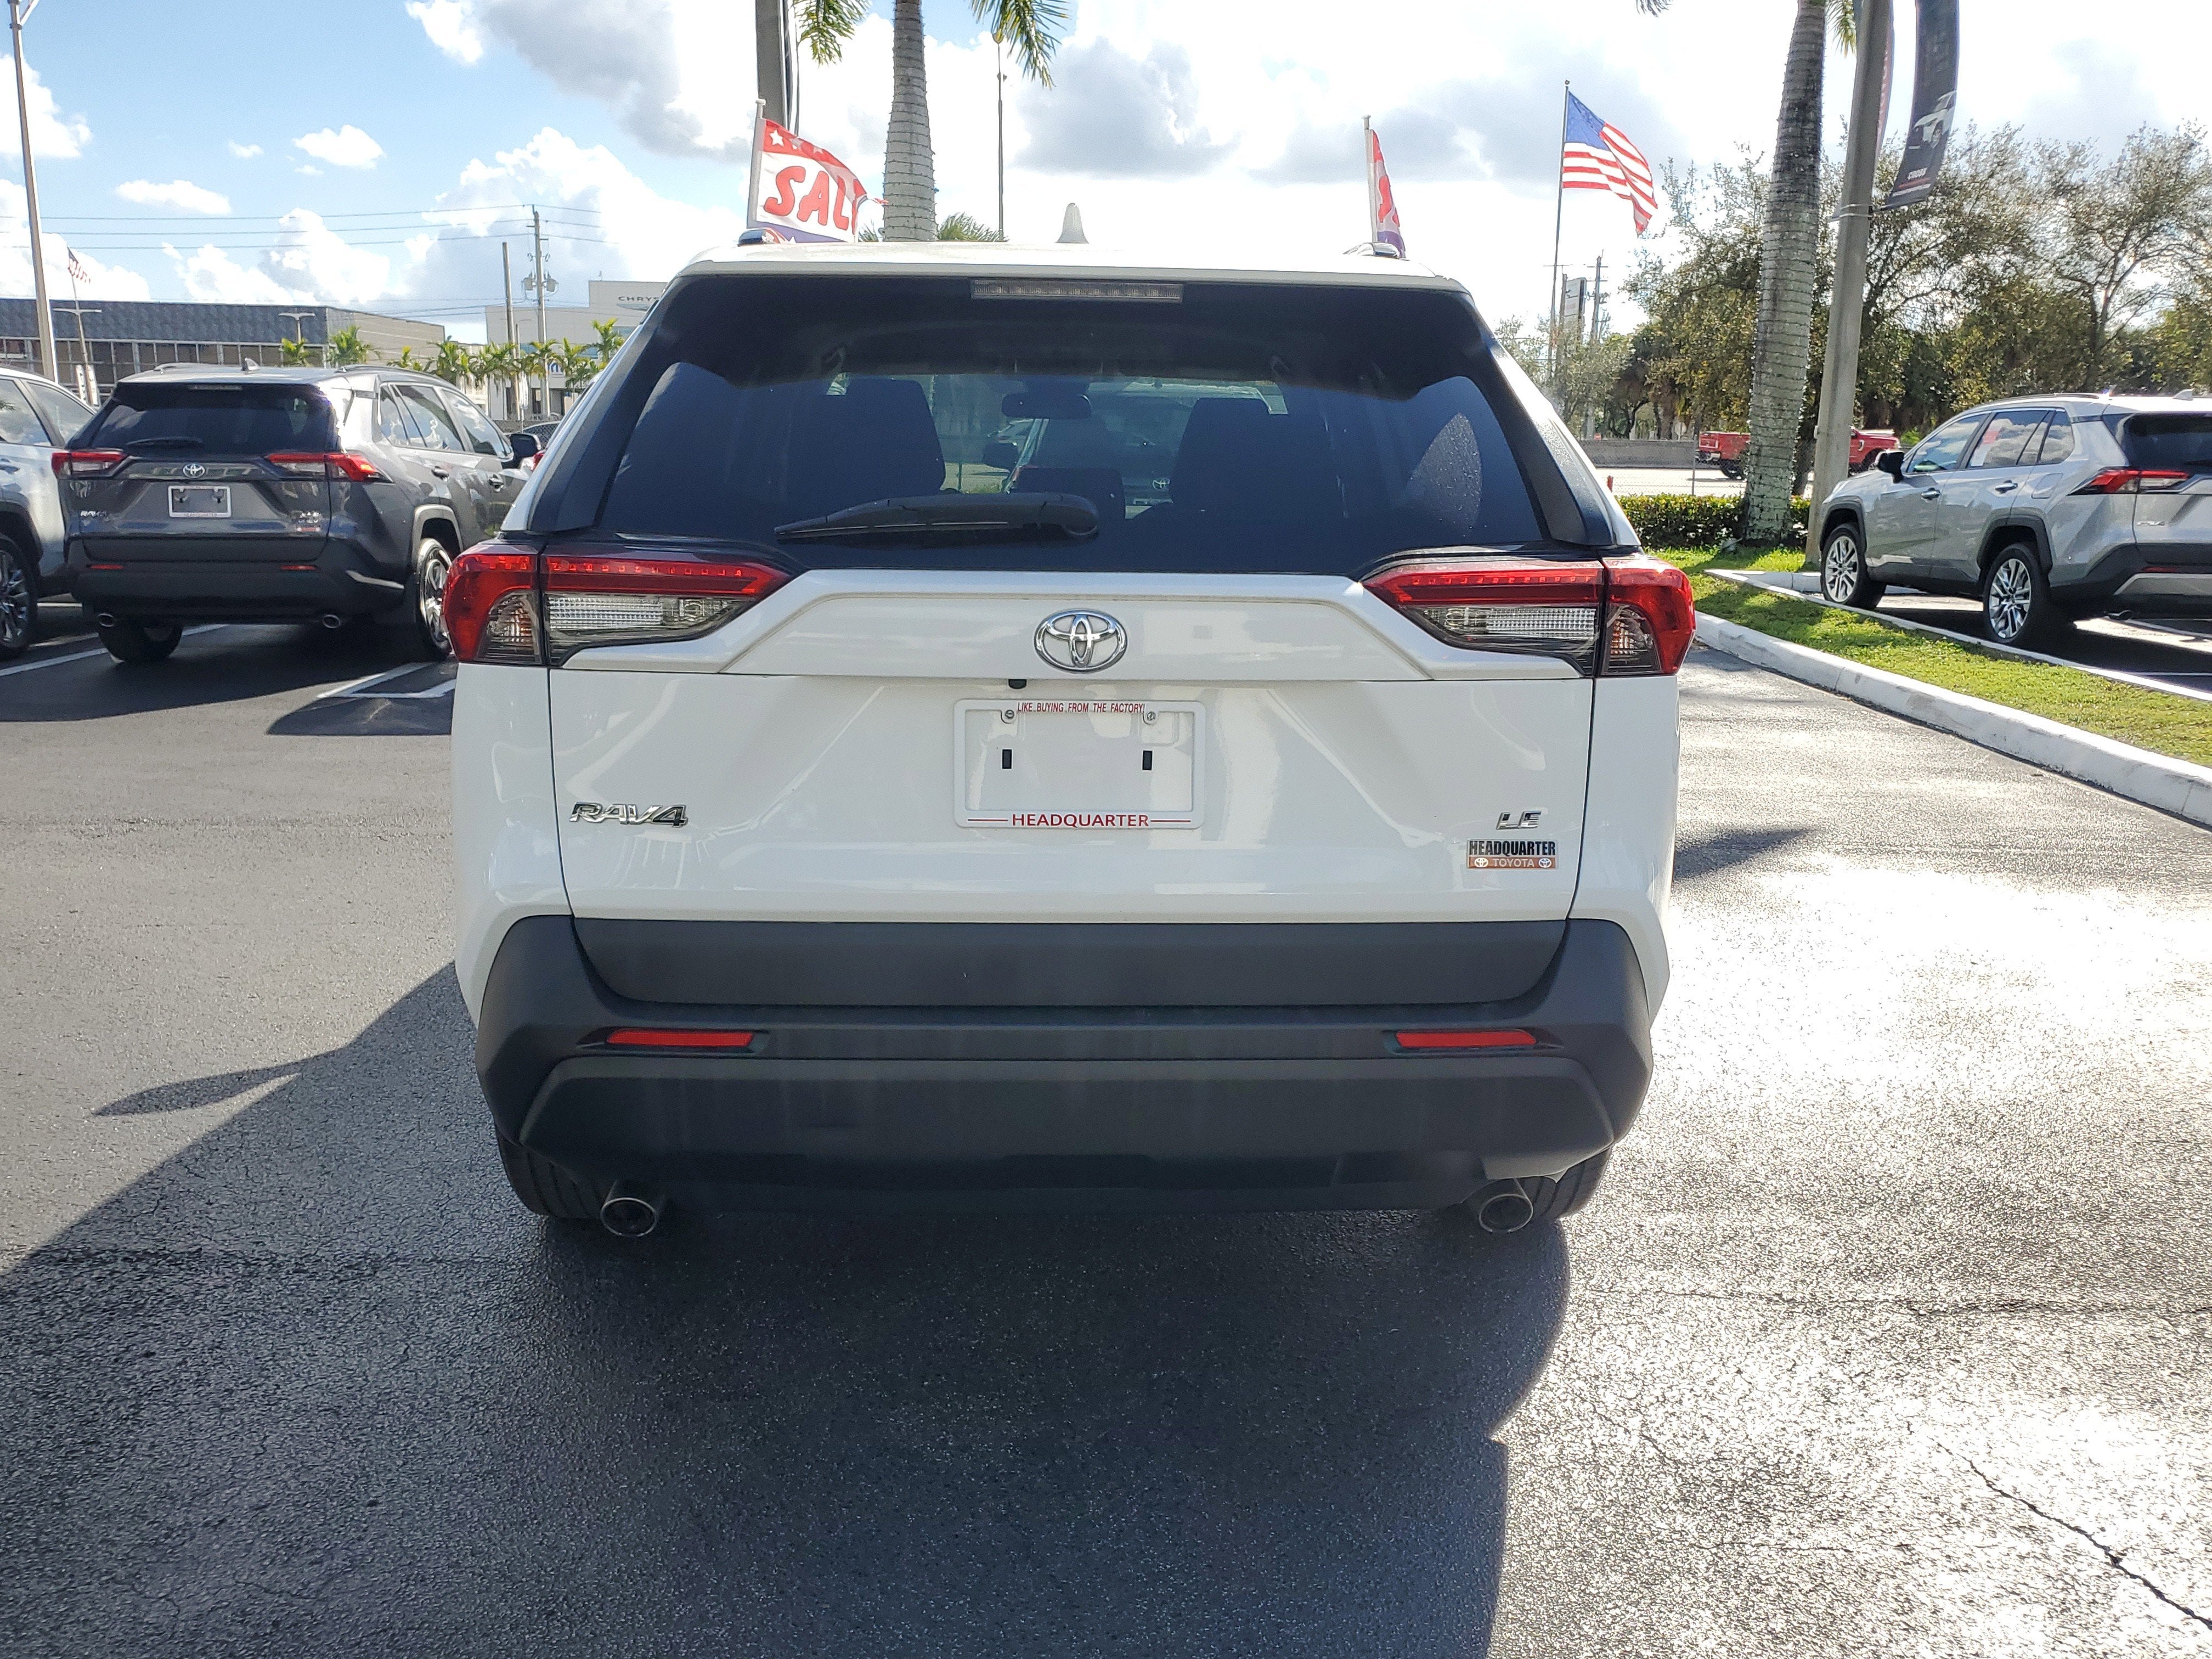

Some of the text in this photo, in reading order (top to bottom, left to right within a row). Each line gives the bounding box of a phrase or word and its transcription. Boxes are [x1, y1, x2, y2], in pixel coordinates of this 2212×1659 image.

[1017, 702, 1145, 713] LIKE BUYING FROM THE FACTORY!
[569, 802, 688, 827] RAV4
[1012, 814, 1149, 828] HEADQUARTER
[1496, 810, 1542, 830] LE
[1469, 840, 1556, 856] HEADQUARTER
[1492, 859, 1534, 867] TOYOTA
